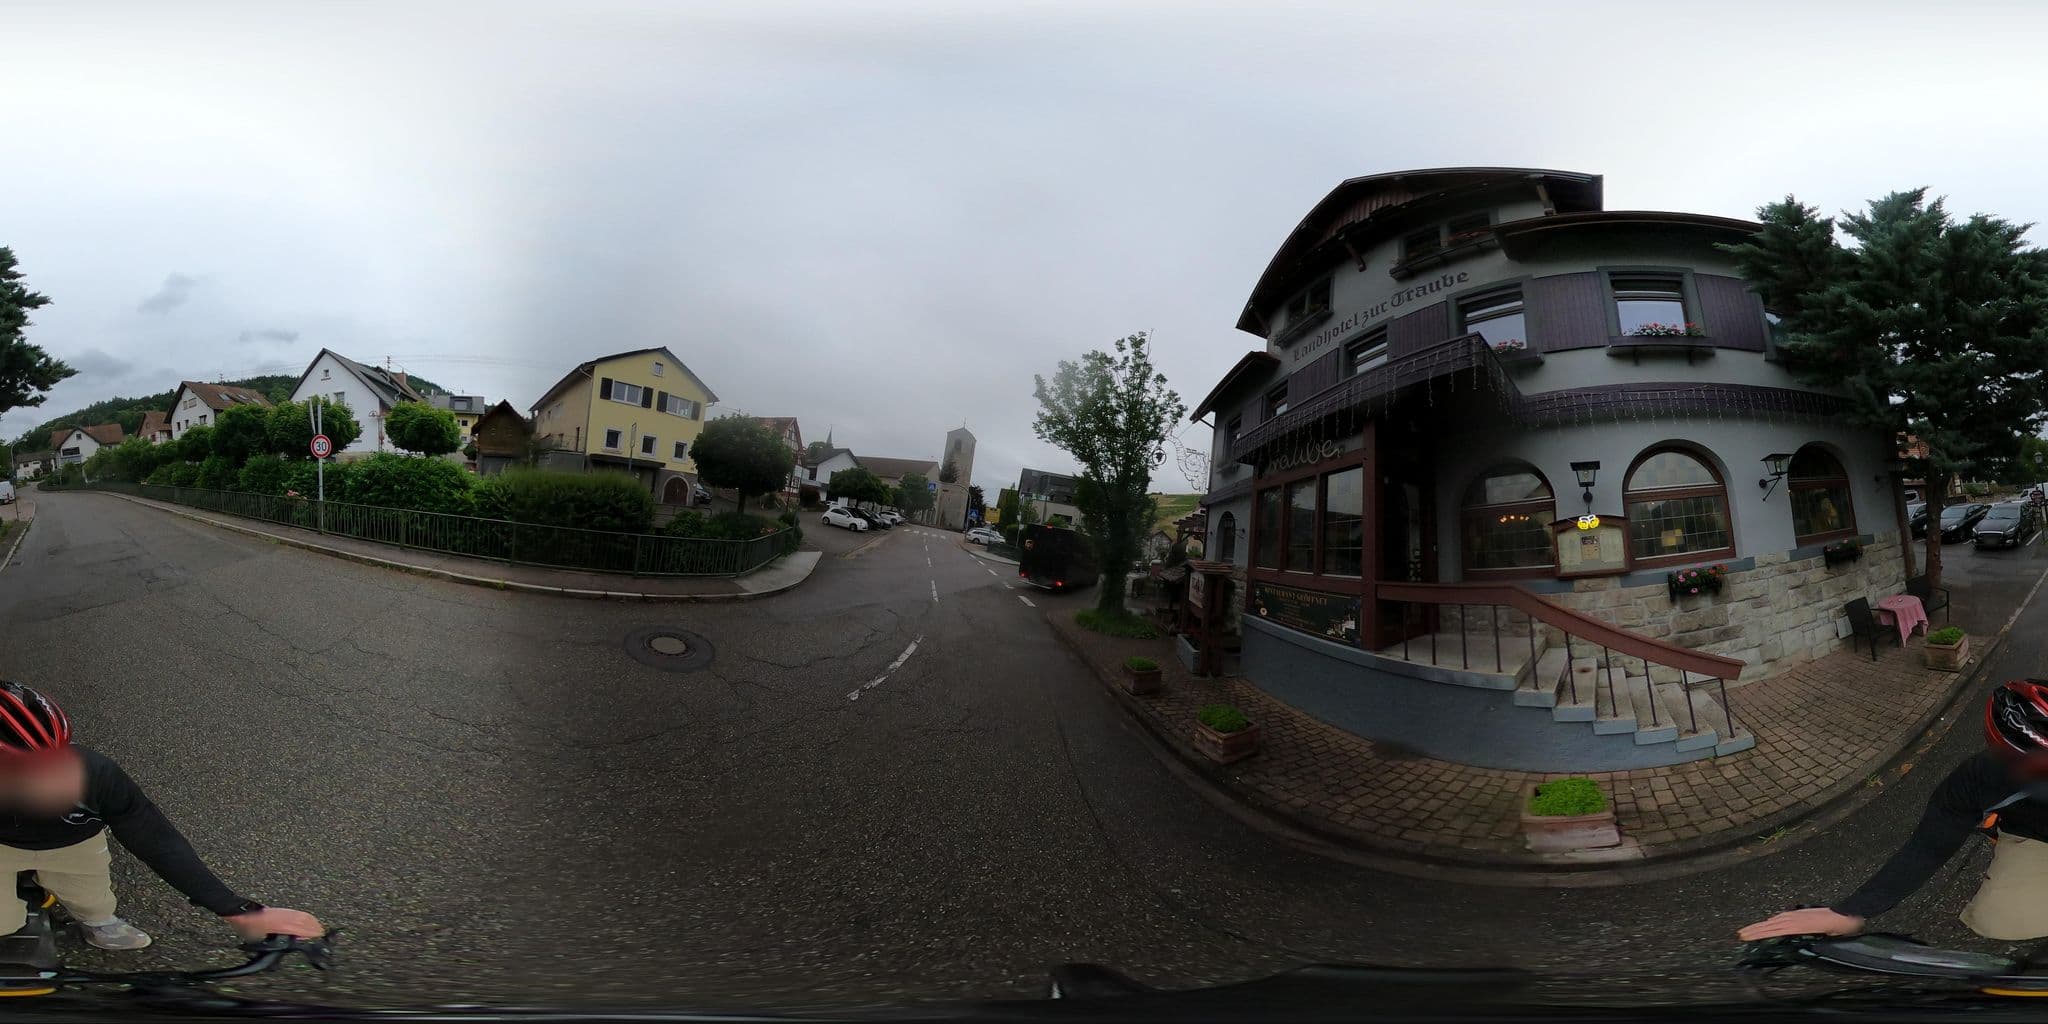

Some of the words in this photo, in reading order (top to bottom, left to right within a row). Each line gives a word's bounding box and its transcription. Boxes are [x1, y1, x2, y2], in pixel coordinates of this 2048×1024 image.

[1294, 312, 1359, 362] Landhotel
[1361, 300, 1388, 328] zur
[1390, 271, 1471, 308] Traube
[316, 441, 327, 452] 30
